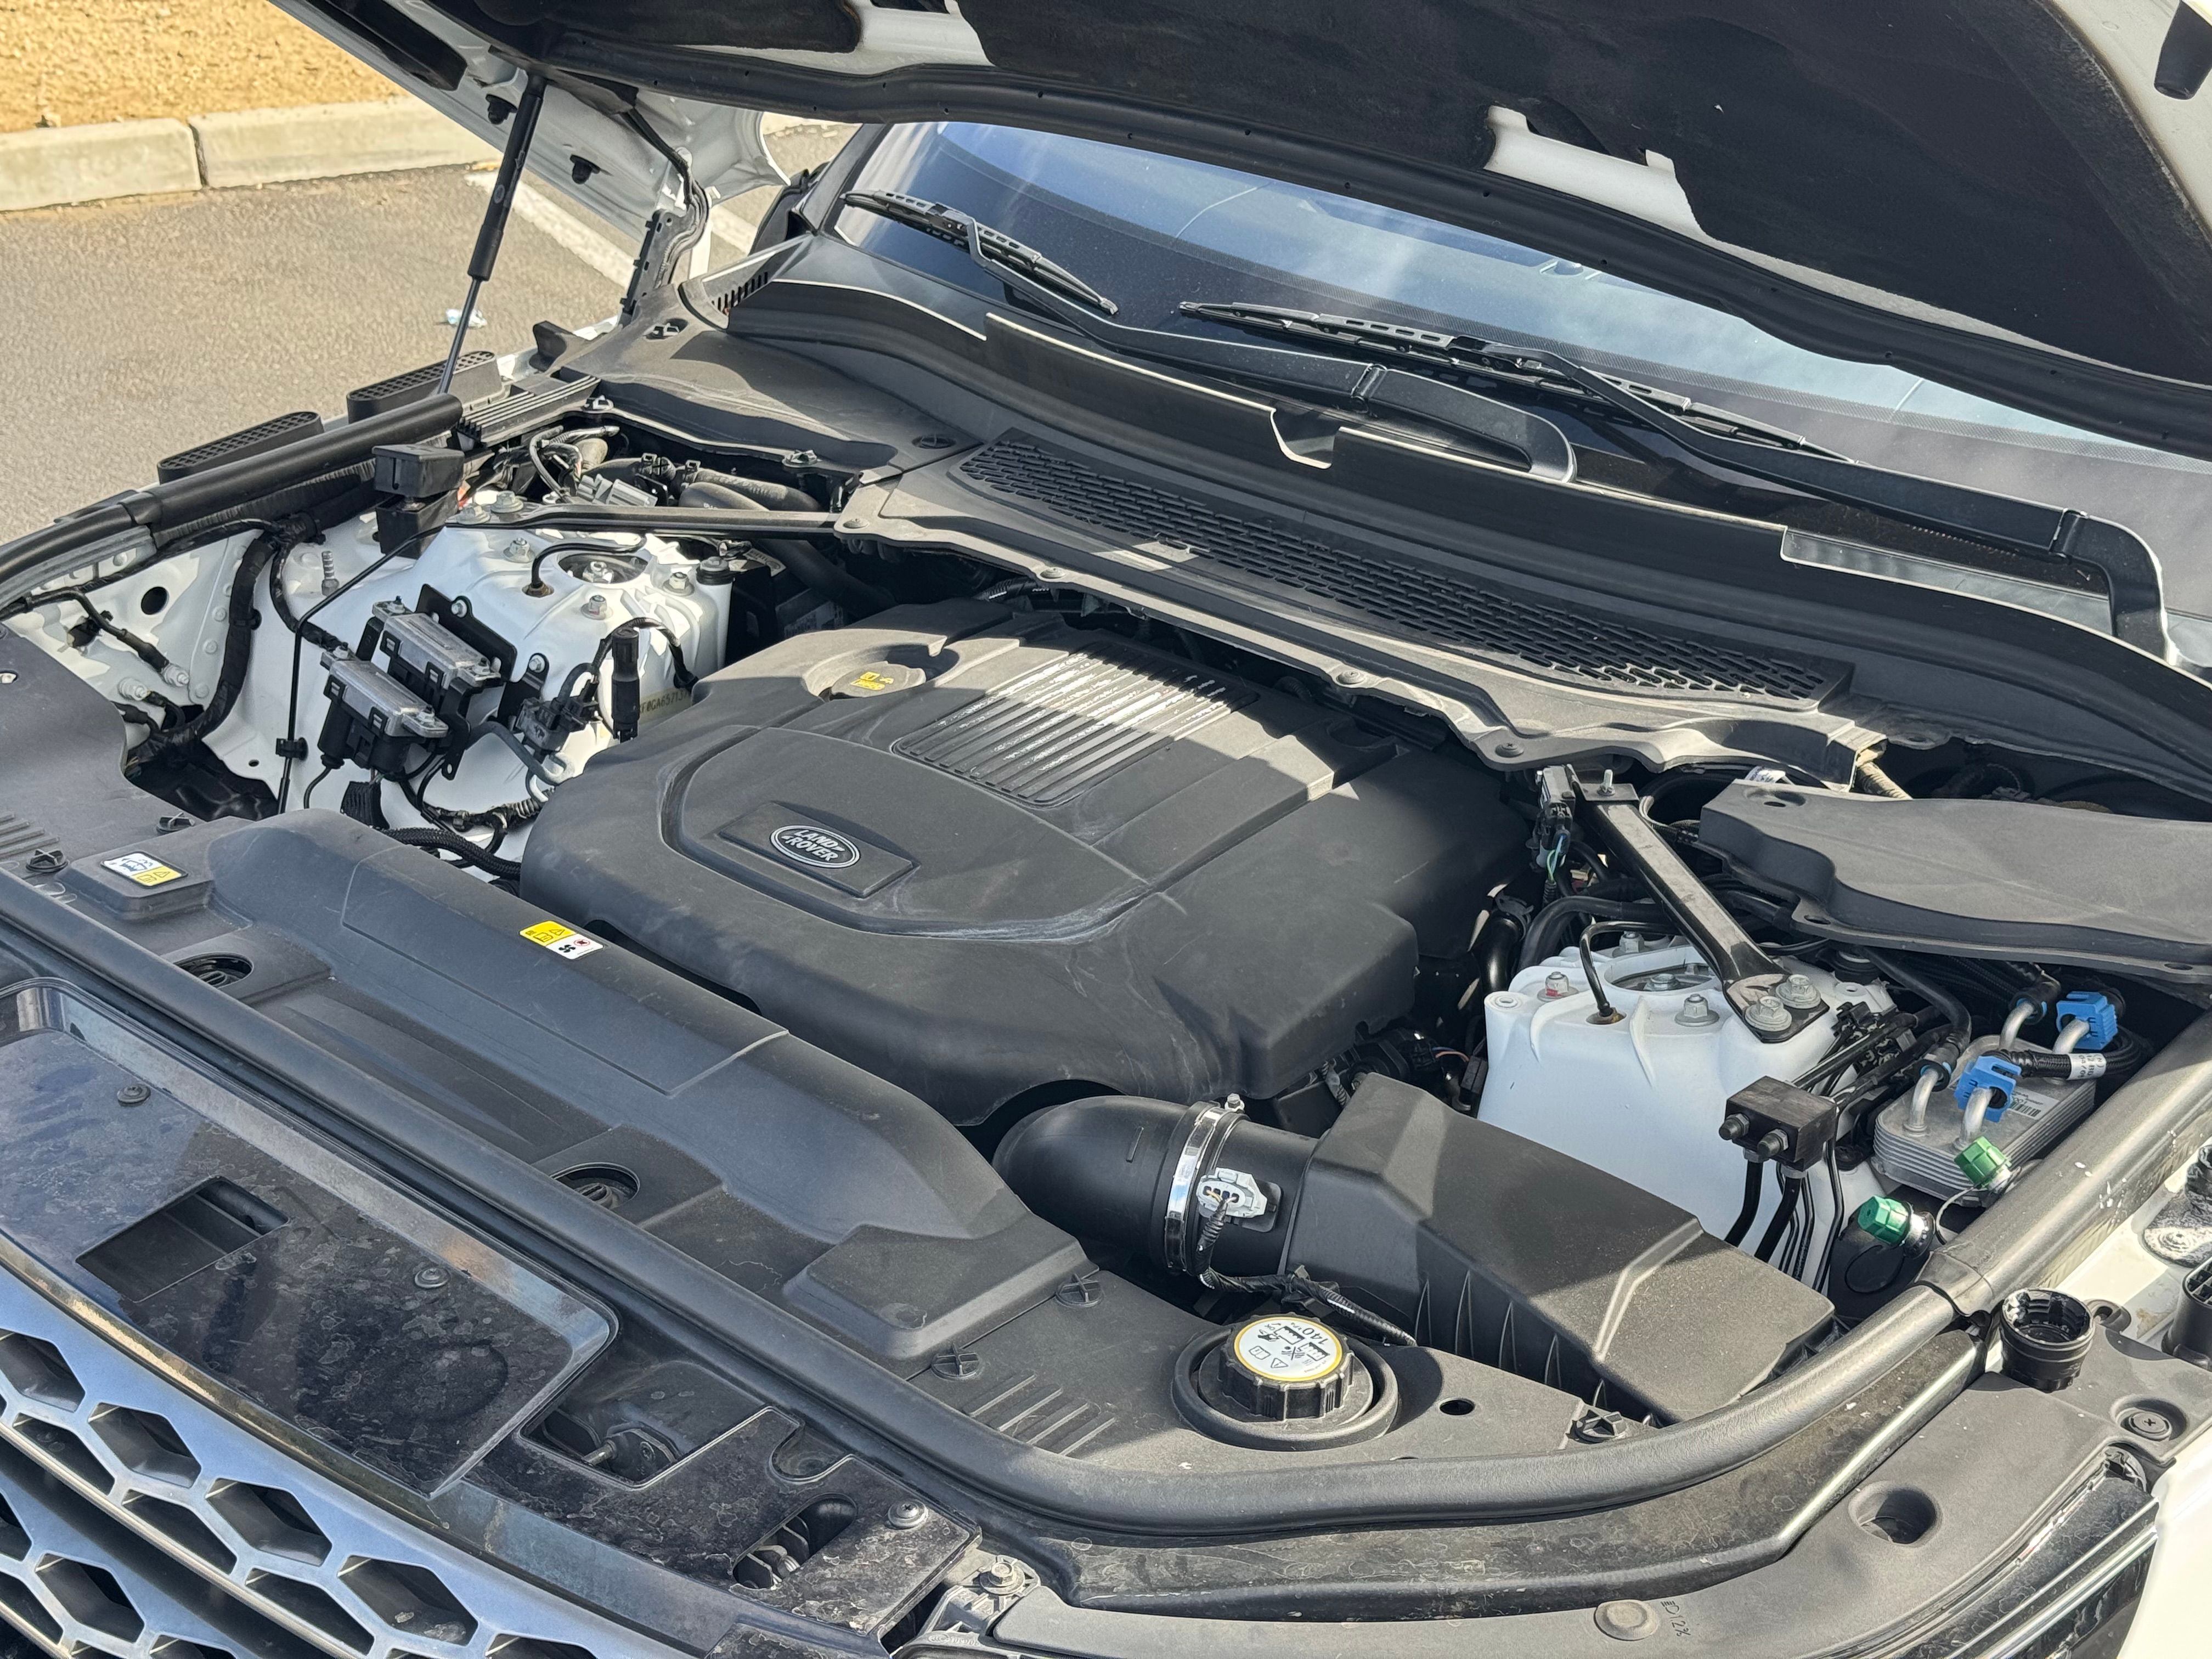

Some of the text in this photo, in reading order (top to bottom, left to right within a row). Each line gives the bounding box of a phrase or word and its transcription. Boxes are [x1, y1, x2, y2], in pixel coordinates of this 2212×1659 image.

[785, 836, 838, 861] ROVER
[794, 830, 837, 849] LAND
[1302, 1328, 1329, 1344] 140
